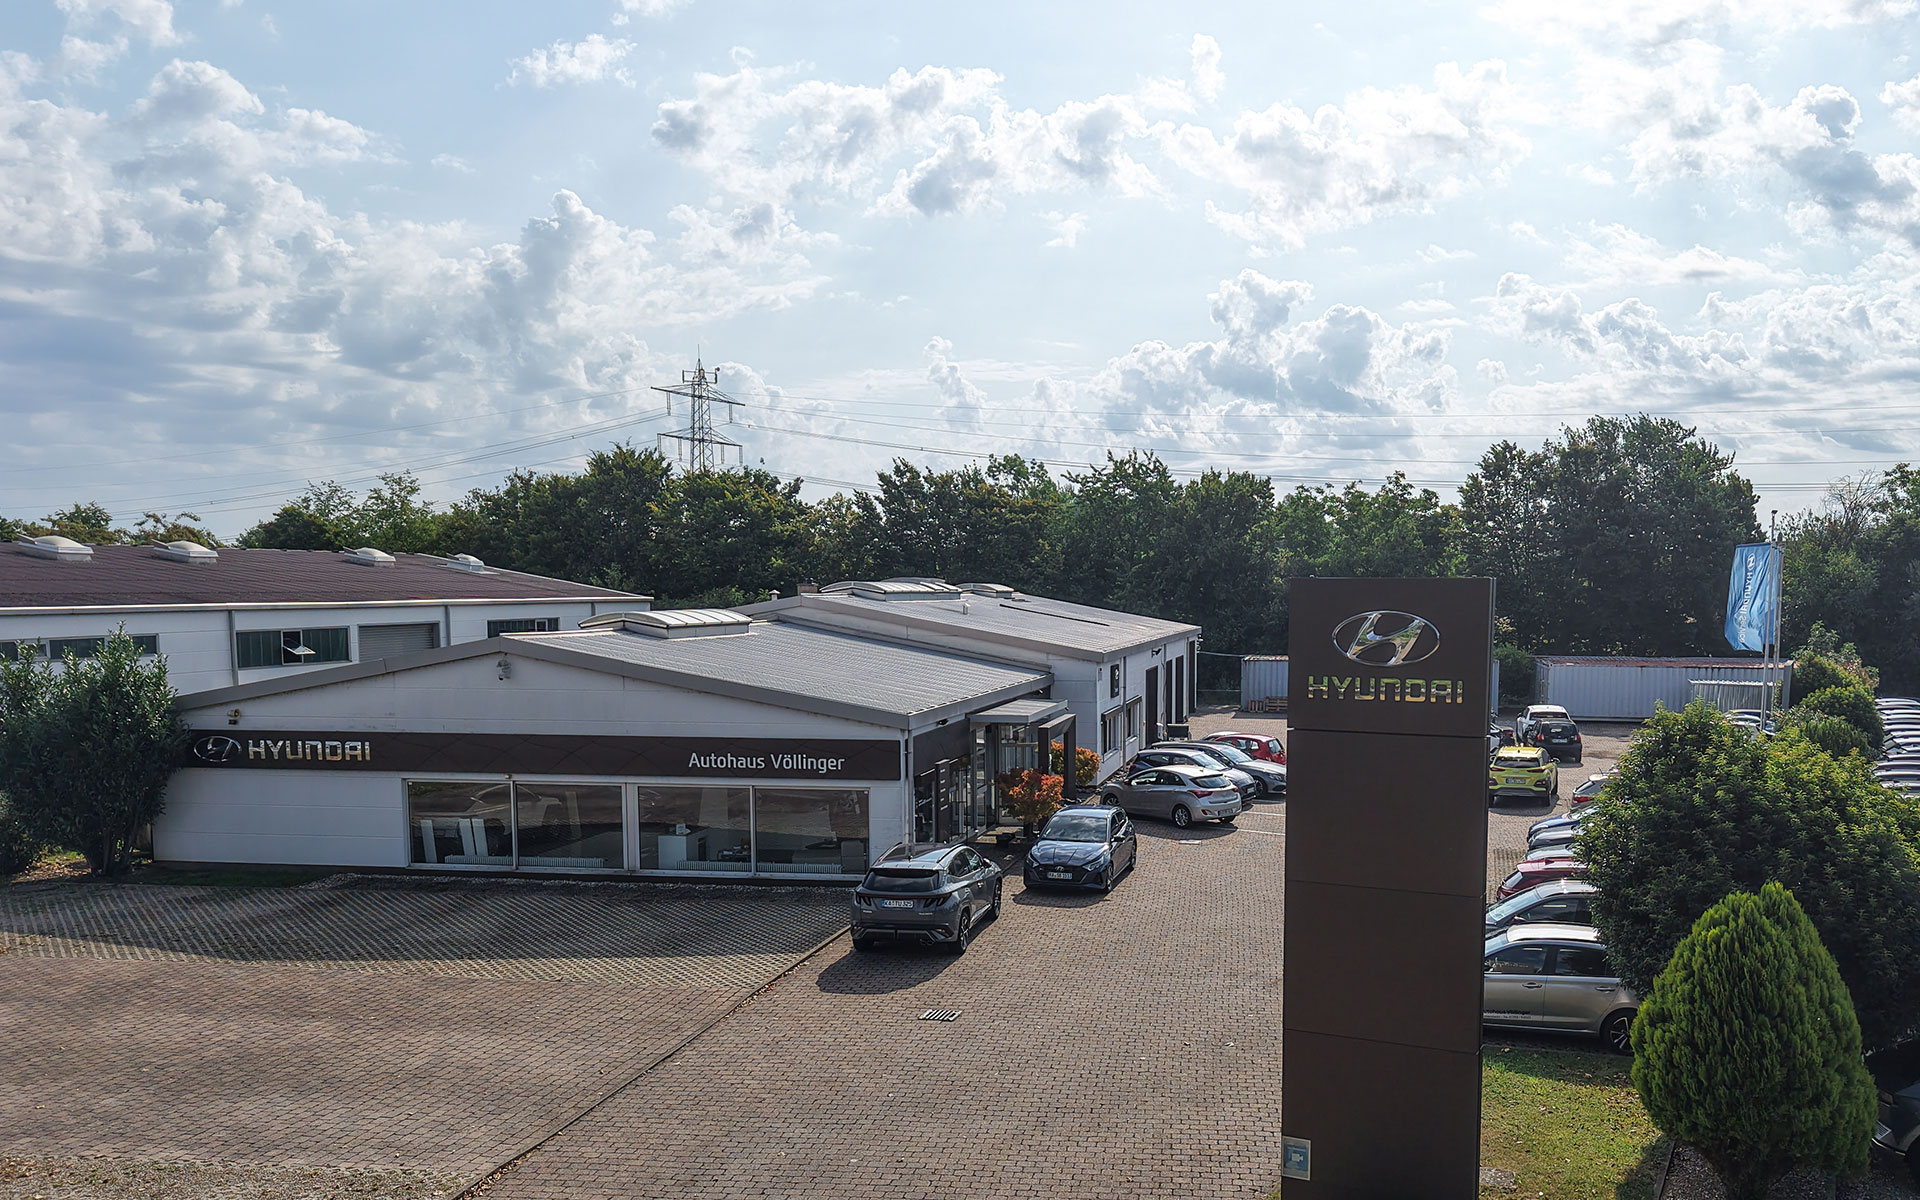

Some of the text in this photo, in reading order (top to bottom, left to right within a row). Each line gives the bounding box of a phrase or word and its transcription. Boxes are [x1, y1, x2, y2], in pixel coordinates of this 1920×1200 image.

[1307, 675, 1464, 704] HYUNDAI
[248, 739, 371, 761] HYUNDAI
[688, 752, 846, 774] Autohaus Völlinger
